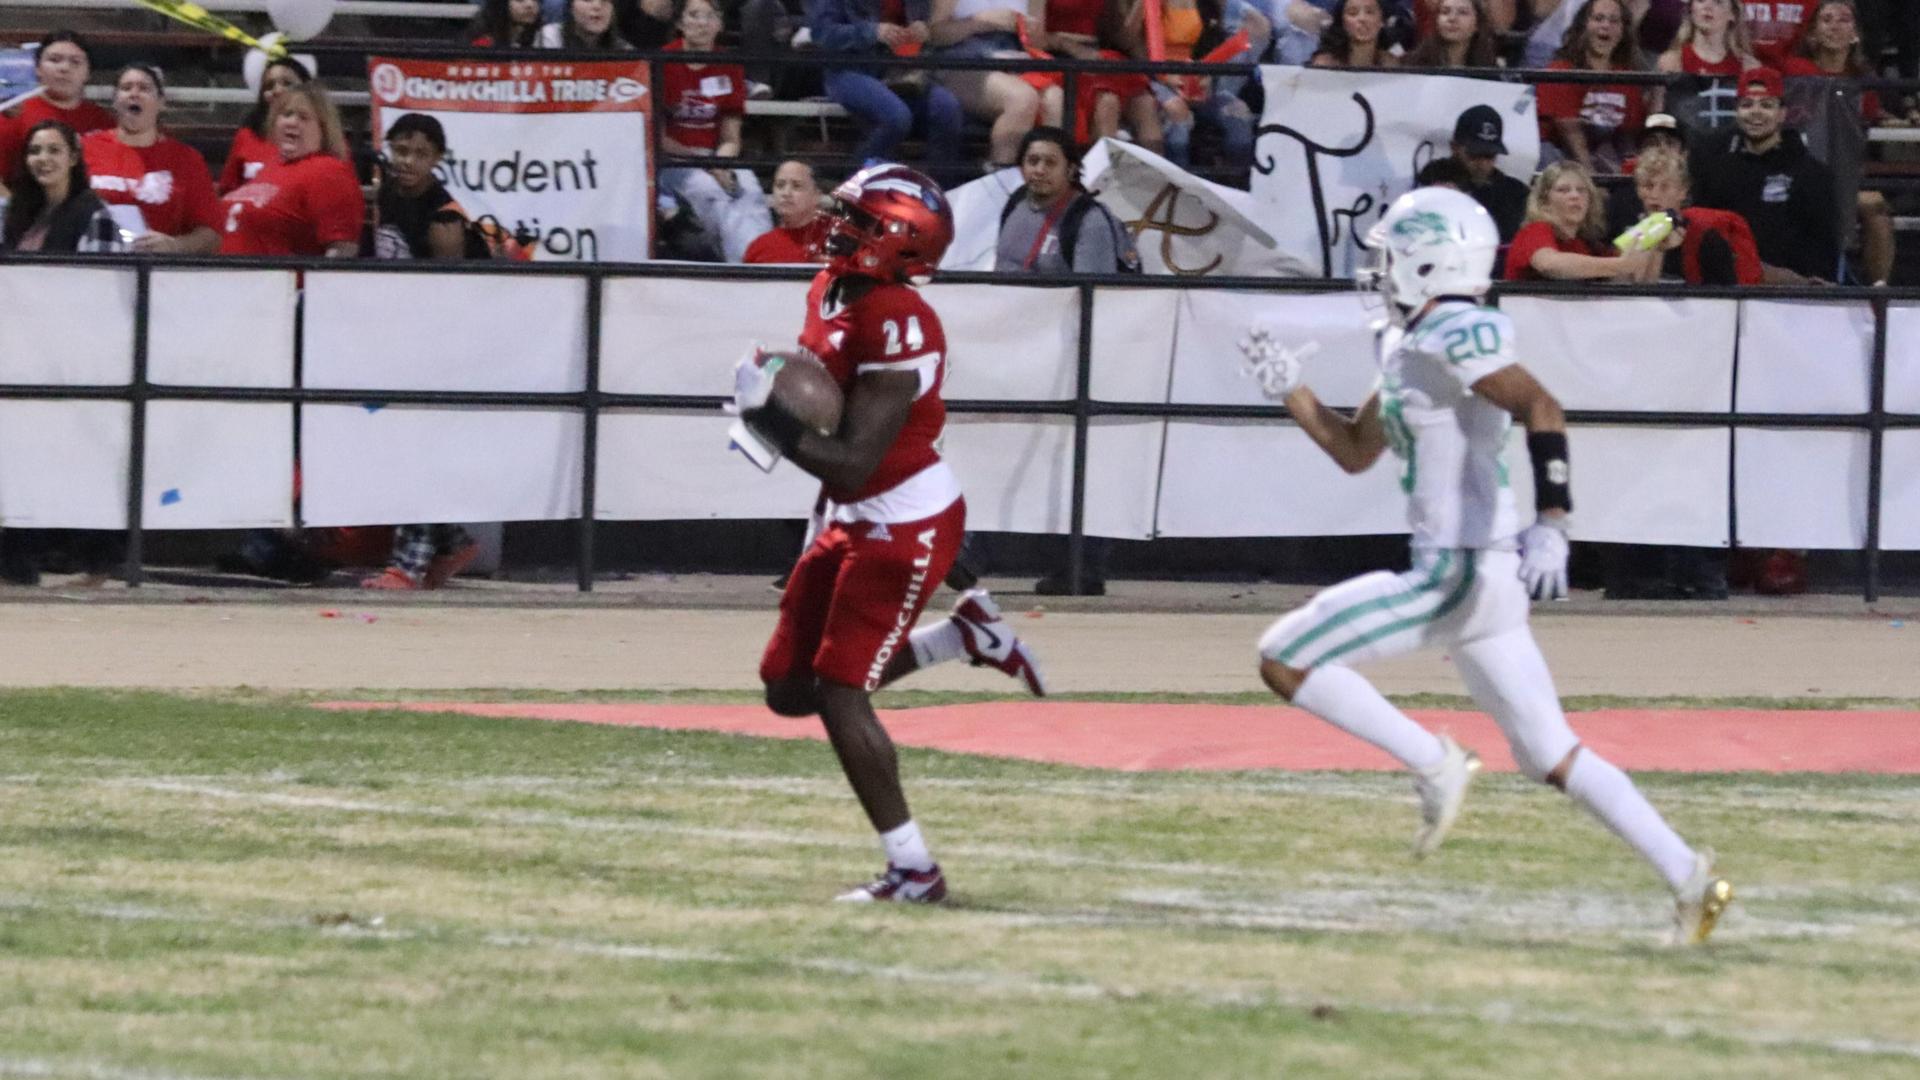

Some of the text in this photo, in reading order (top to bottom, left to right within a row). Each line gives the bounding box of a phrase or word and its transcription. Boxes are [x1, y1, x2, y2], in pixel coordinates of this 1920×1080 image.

[404, 77, 547, 102] CHOWCHILLA
[551, 80, 609, 102] TRIBE
[882, 315, 924, 355] 24
[1442, 322, 1502, 365] 20
[864, 527, 937, 693] CHOWCHILLA
